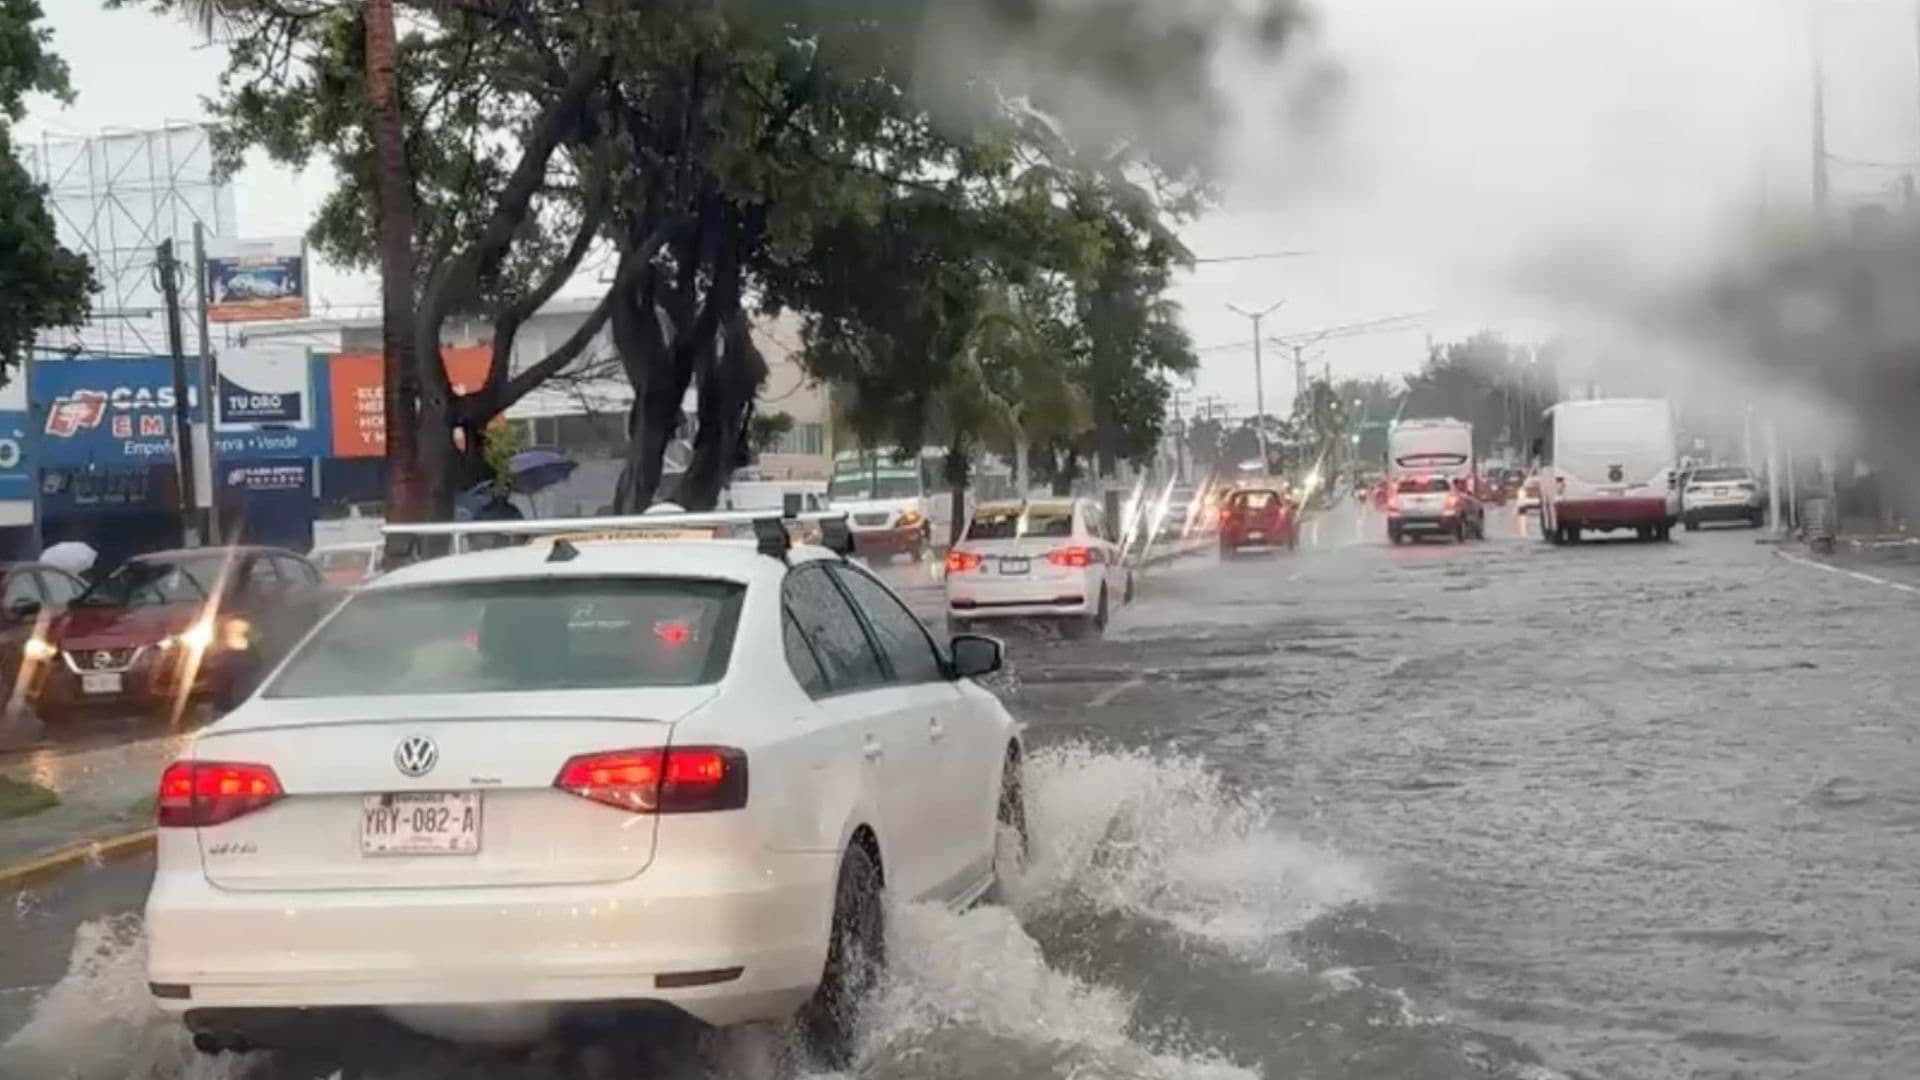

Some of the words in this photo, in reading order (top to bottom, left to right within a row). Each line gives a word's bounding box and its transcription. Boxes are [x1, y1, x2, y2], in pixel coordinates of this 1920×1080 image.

[111, 386, 198, 409] CAS
[229, 396, 247, 409] TU
[364, 807, 474, 835] YRY-082-A
